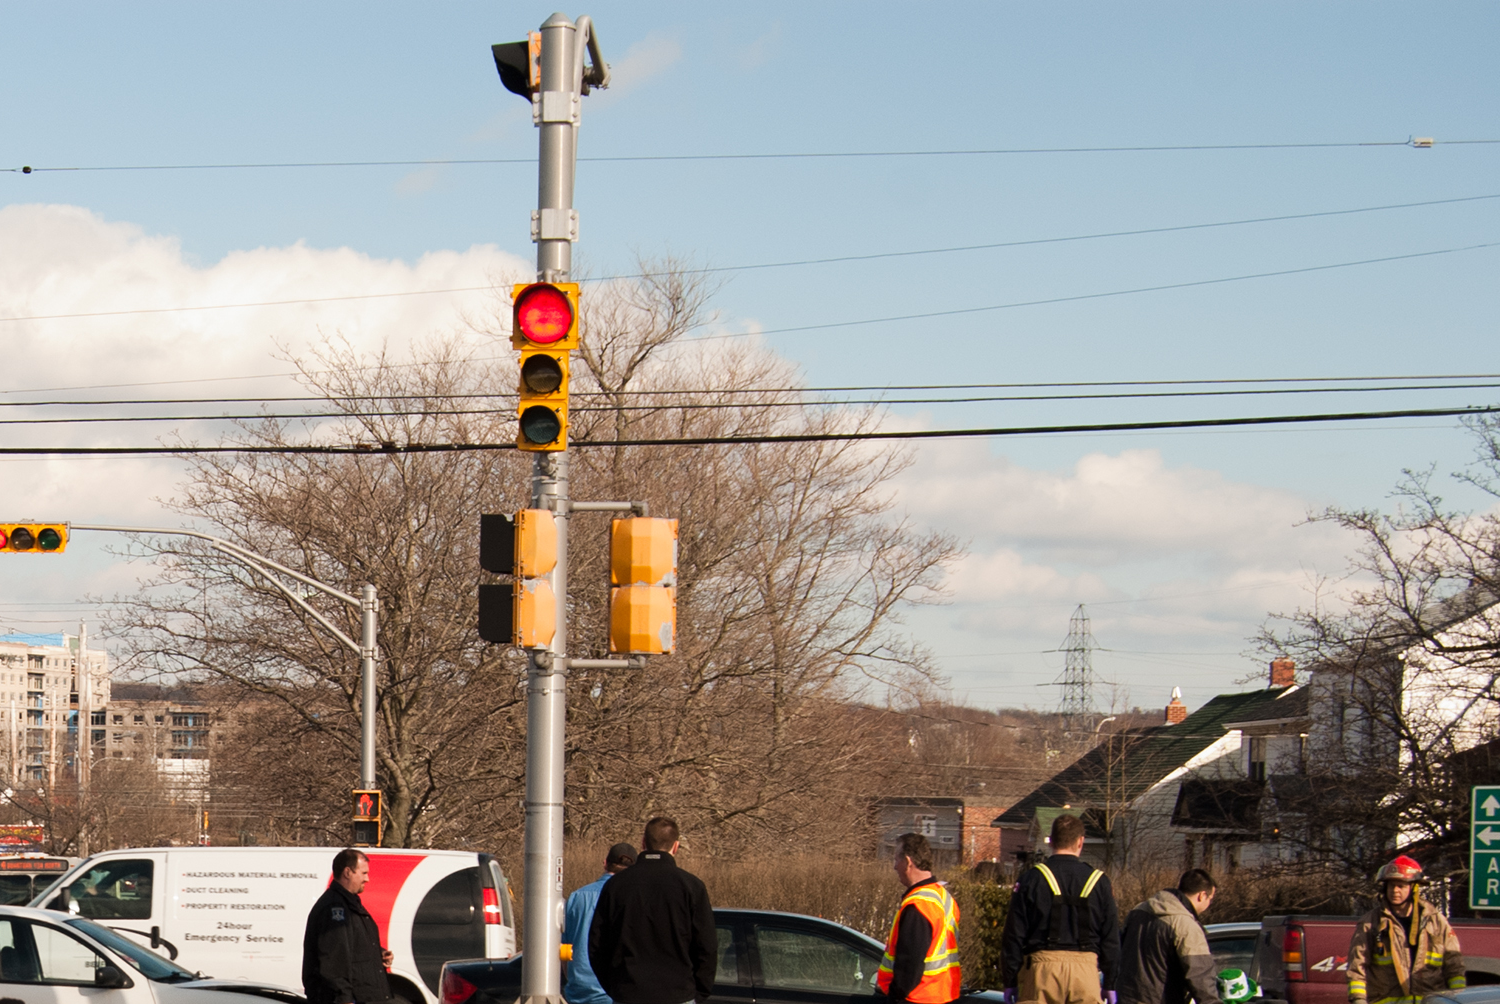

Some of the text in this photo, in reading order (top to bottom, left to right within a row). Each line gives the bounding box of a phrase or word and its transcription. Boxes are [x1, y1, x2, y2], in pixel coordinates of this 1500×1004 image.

[216, 921, 253, 930] 24hour
[184, 933, 284, 943] Emergency Service
